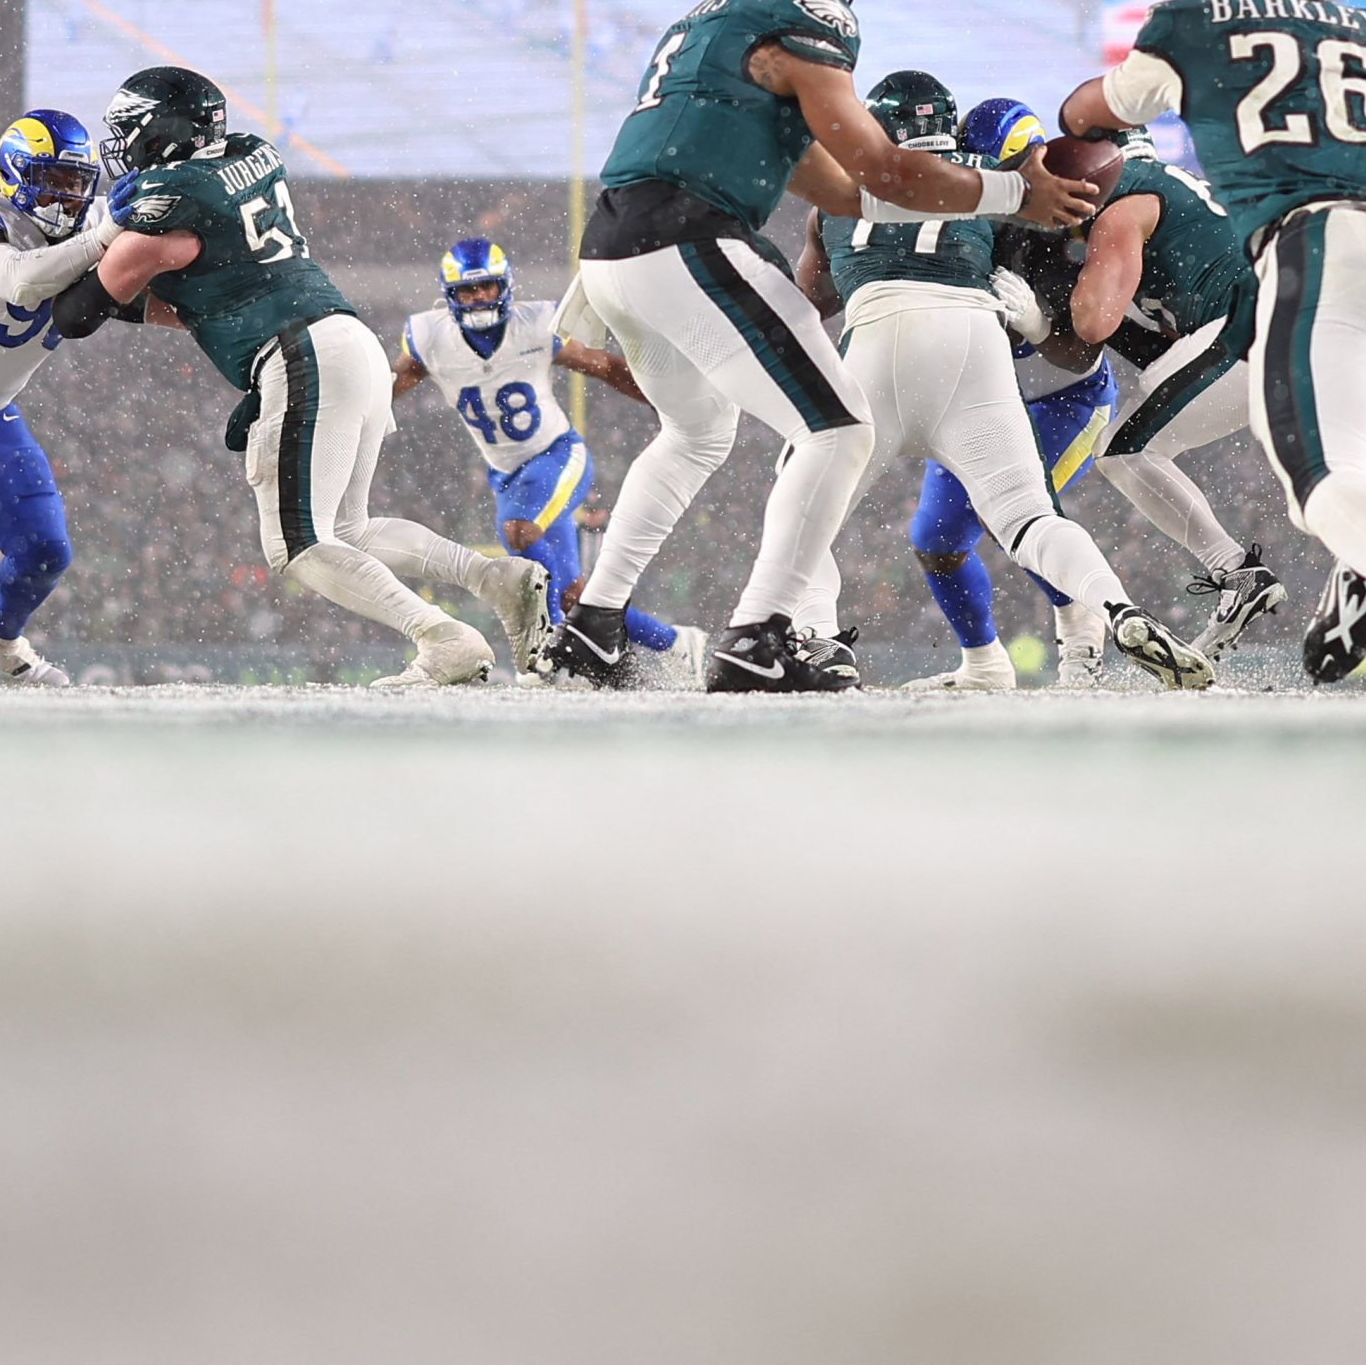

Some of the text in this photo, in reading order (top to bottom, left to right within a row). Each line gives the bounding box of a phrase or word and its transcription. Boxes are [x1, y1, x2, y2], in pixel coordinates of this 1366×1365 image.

[635, 32, 686, 113] 1
[907, 140, 935, 149] CHOOSE
[239, 179, 311, 264] 51
[456, 381, 542, 445] 48
